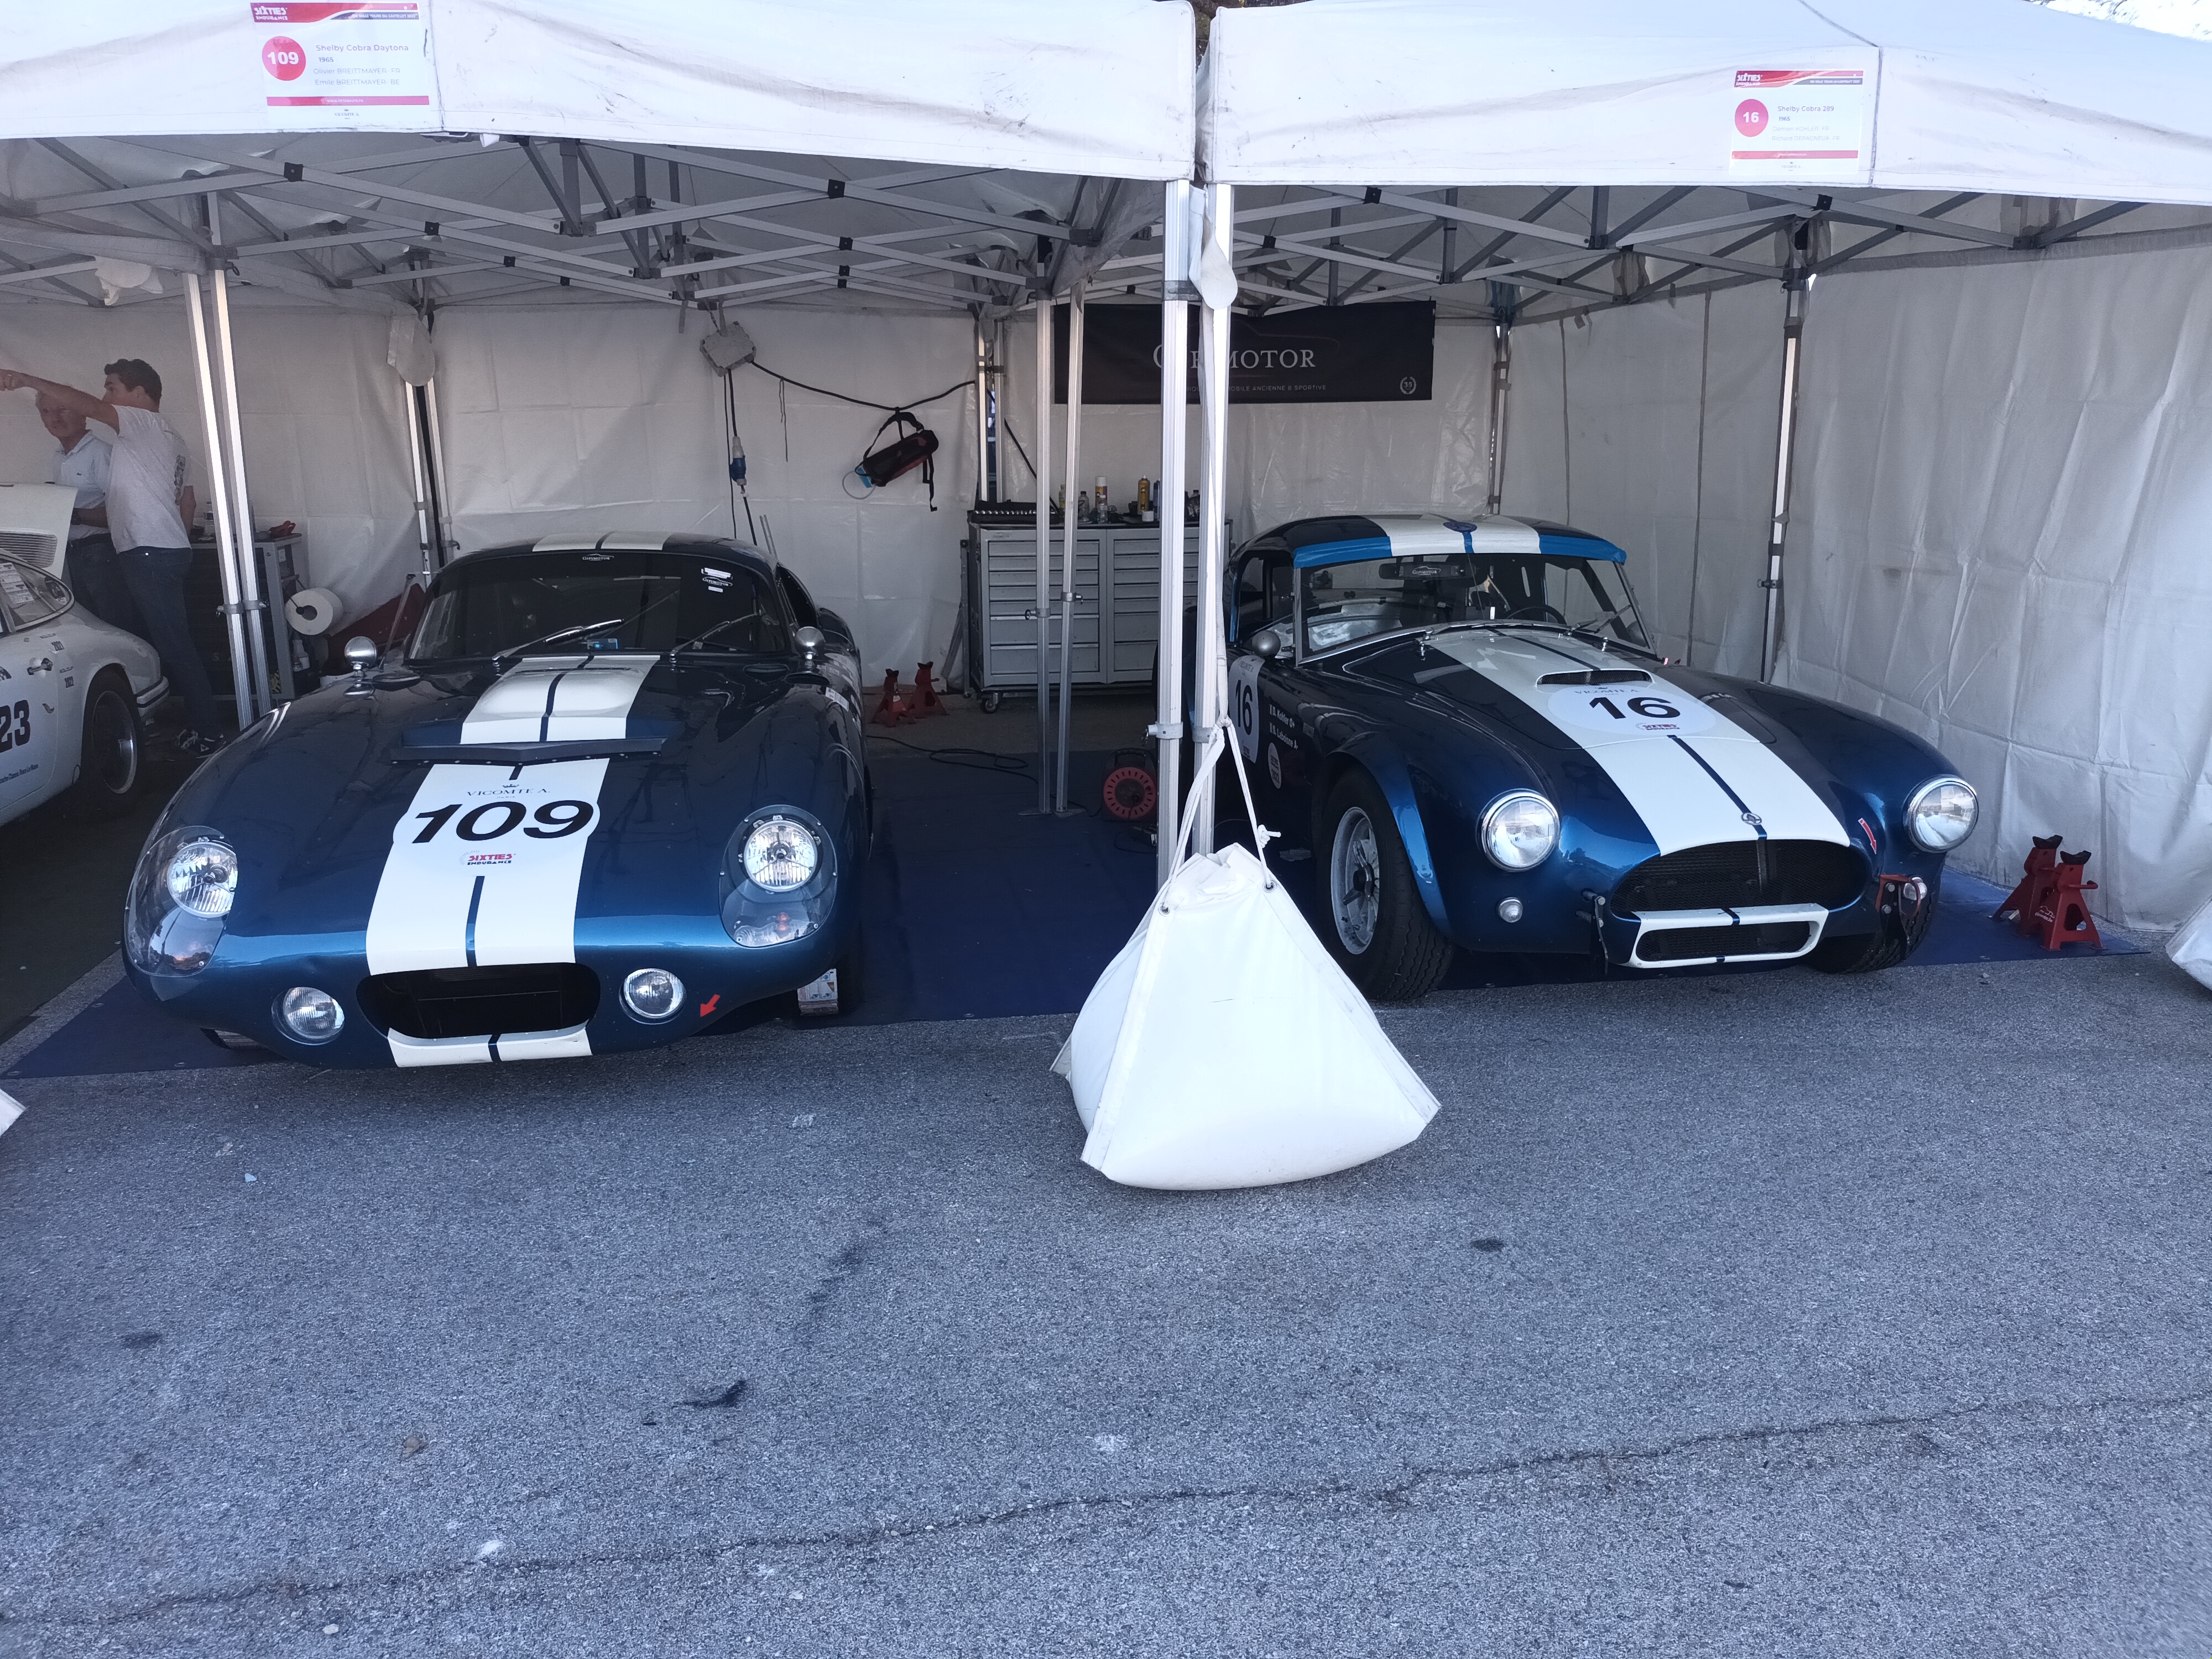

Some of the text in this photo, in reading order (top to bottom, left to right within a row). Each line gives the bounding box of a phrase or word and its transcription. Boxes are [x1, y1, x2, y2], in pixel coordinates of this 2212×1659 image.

[254, 6, 286, 15] SIXTIES
[268, 52, 299, 65] 109
[1743, 112, 1759, 123] 16
[1235, 680, 1253, 735] 16
[1589, 697, 1681, 719] 16
[412, 800, 594, 843] 109
